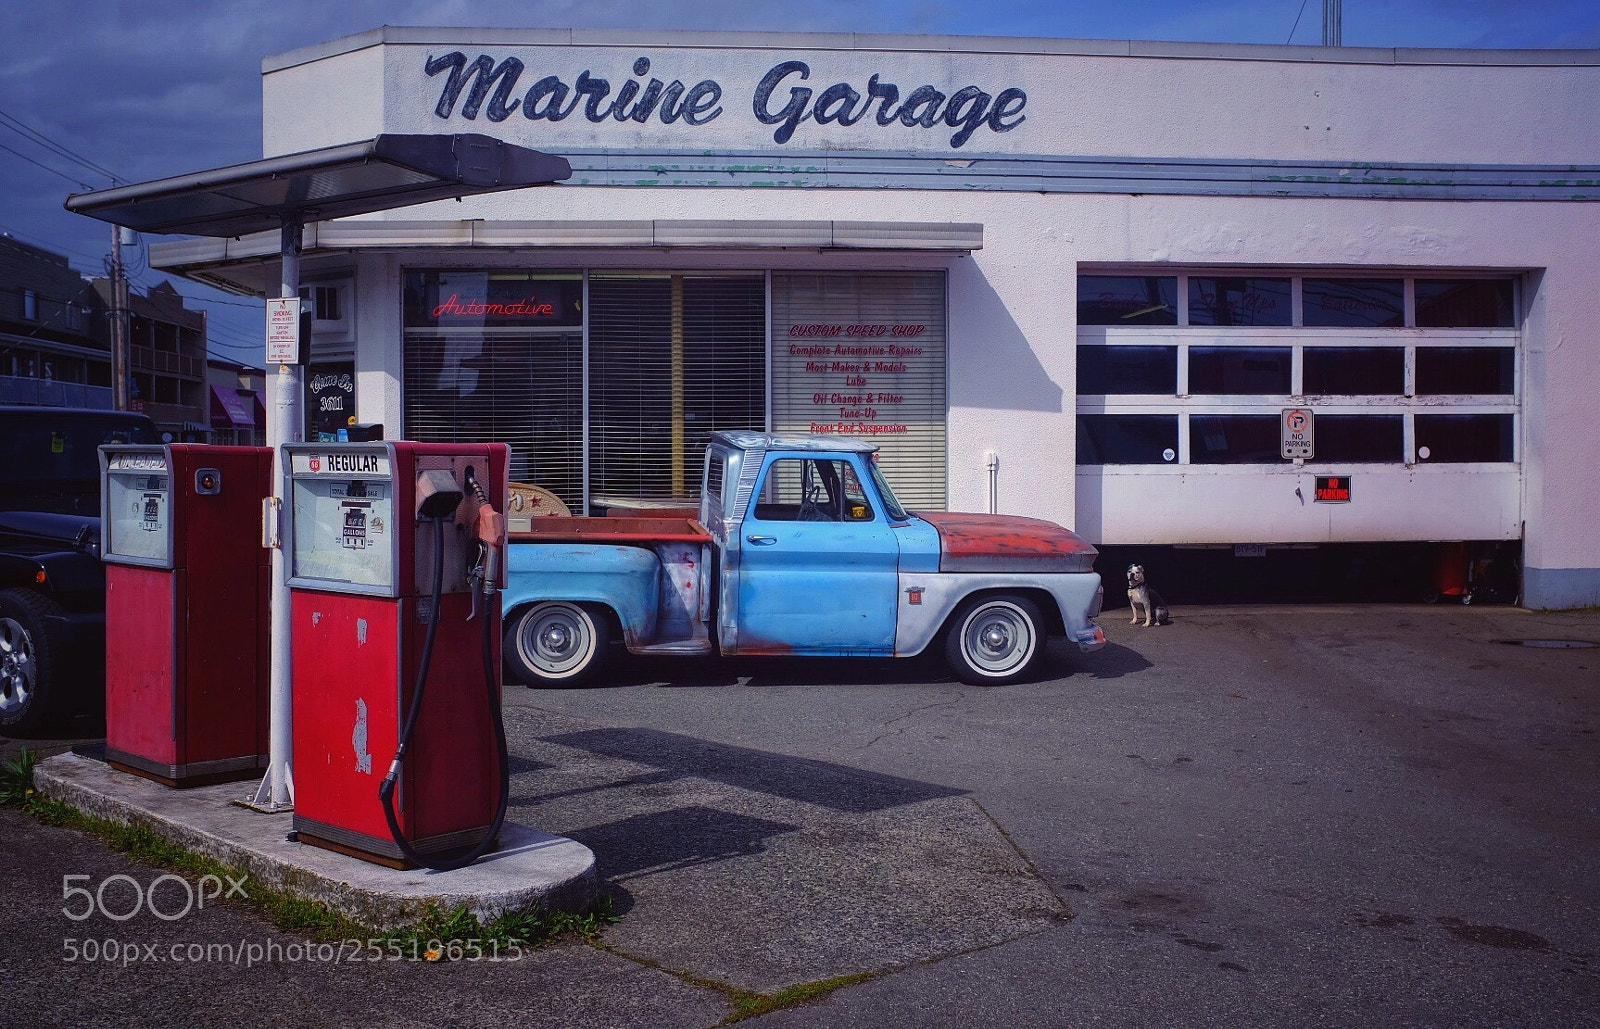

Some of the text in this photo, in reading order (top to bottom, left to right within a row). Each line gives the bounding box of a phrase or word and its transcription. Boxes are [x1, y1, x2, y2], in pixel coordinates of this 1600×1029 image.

[424, 51, 1029, 148] Marine Garage
[433, 293, 554, 317] Automotive
[789, 324, 925, 337] CUSTOM SPEED SHOP
[789, 344, 922, 358] Complete Automotive Repairs
[805, 361, 907, 373] Most Makes & Models
[846, 375, 867, 387] Lube
[320, 395, 344, 412] 3611
[813, 393, 904, 406] Oil Change & Filter
[839, 407, 877, 420] Tune-Up
[810, 422, 908, 435] Front End Suspension
[1284, 440, 1311, 448] PARKING
[327, 454, 379, 472] REGULAR
[1328, 478, 1339, 488] NO
[1317, 488, 1349, 500] PARKING
